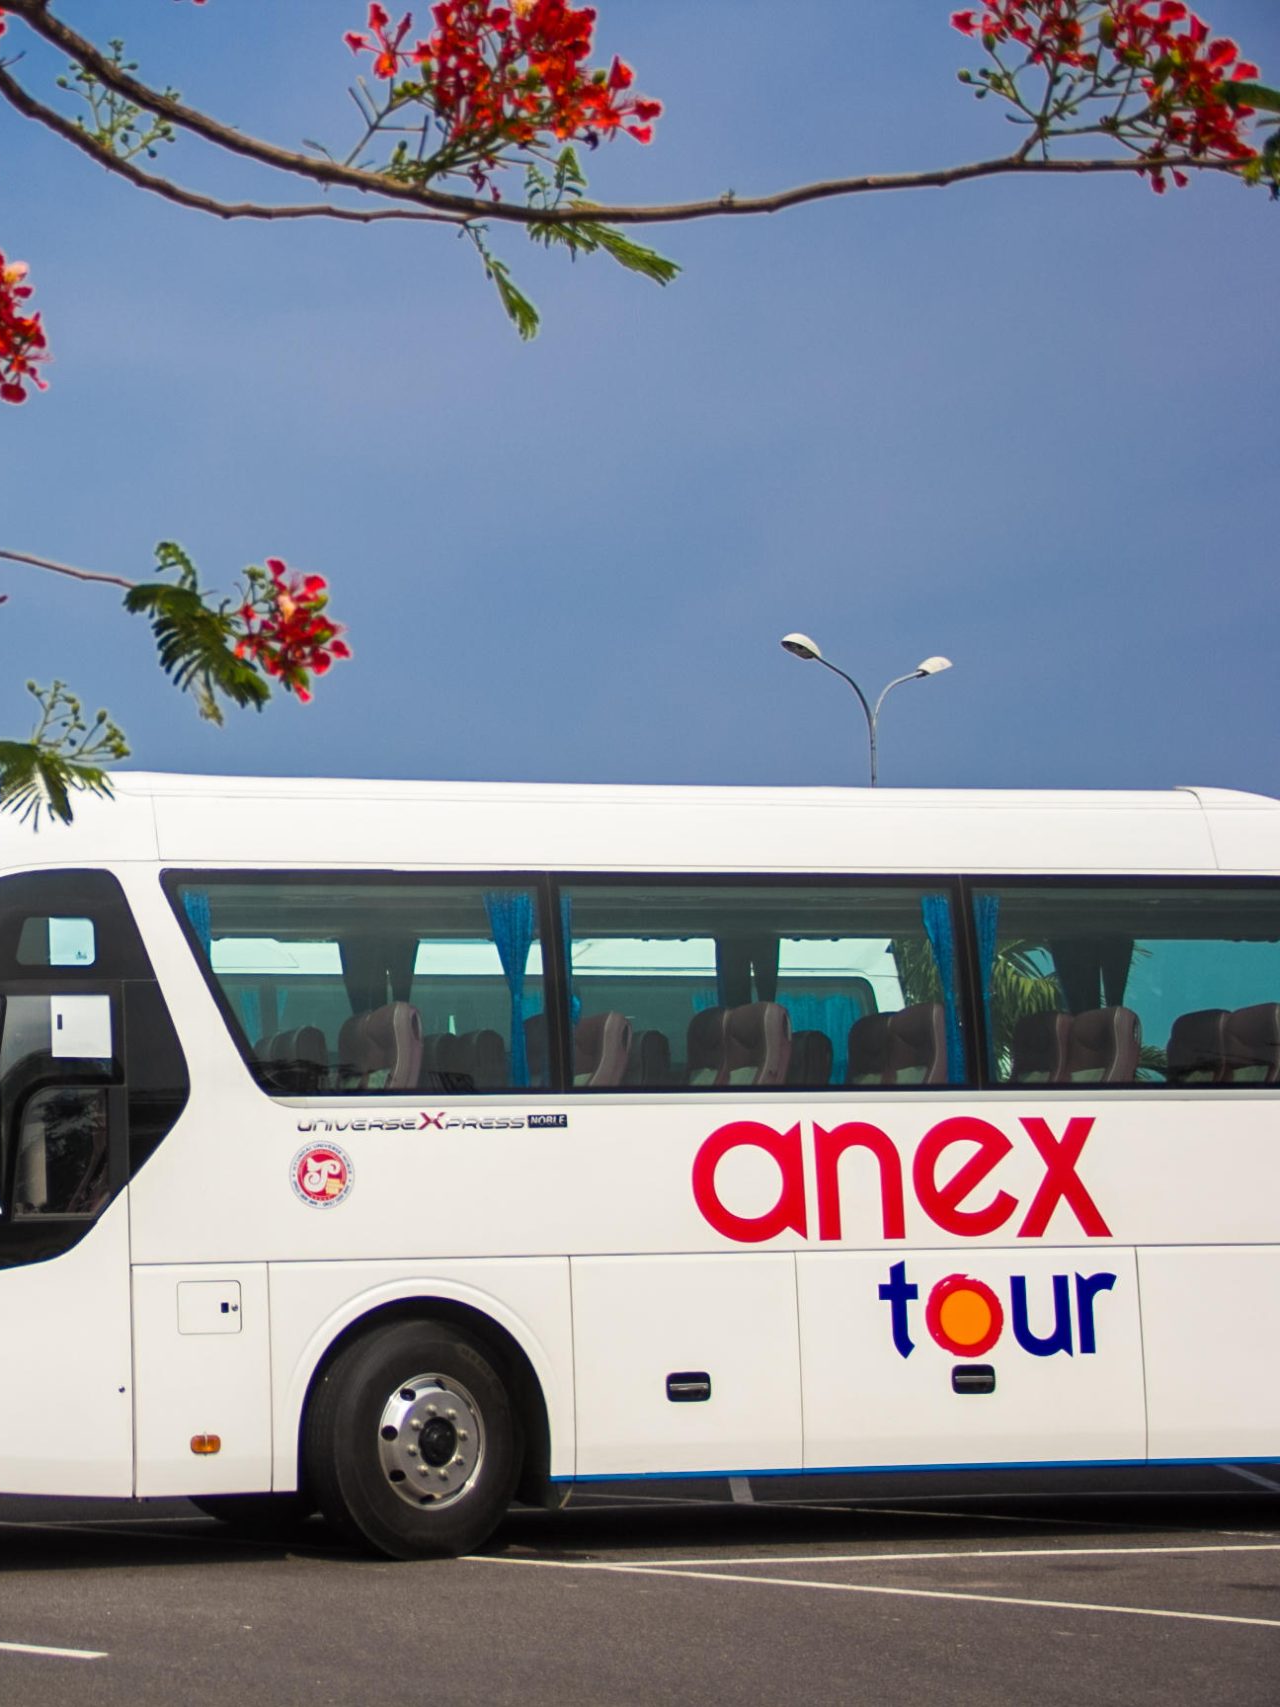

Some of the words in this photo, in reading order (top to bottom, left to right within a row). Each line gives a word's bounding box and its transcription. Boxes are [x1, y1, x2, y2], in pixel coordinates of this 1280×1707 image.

[529, 1115, 567, 1127] NOBLE
[692, 1116, 1113, 1243] anex
[878, 1260, 1117, 1359] tour
